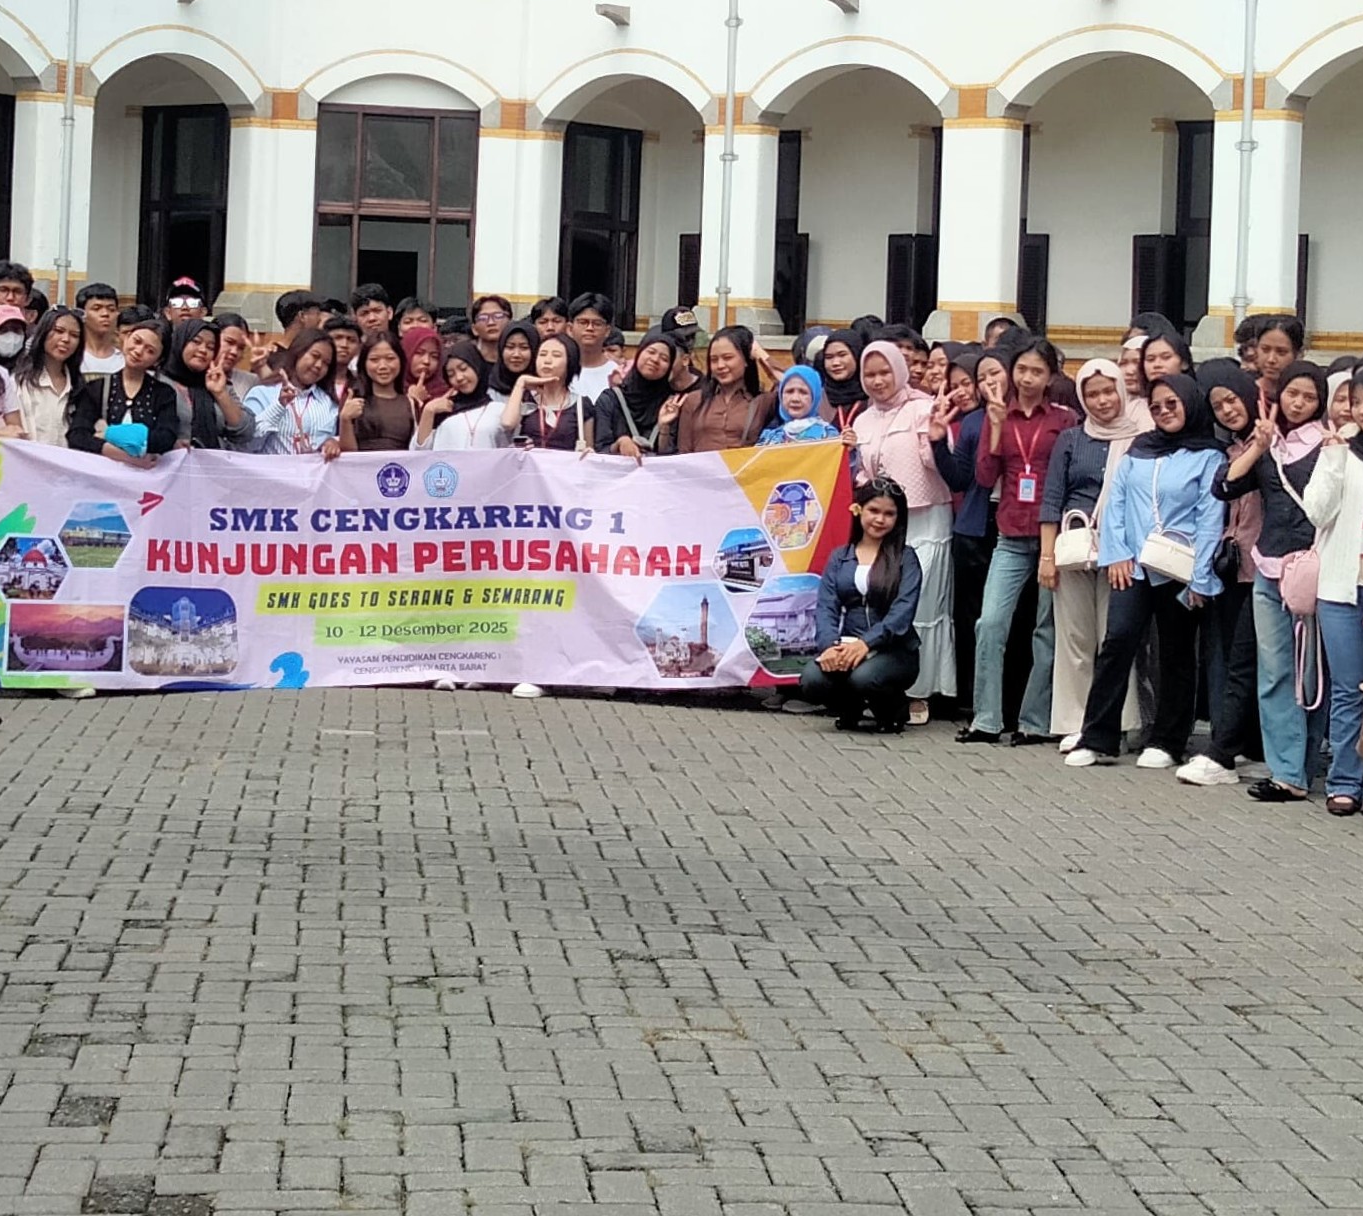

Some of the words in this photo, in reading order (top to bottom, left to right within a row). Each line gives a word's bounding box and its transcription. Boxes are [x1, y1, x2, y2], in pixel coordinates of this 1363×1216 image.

[209, 507, 299, 532] SMK
[310, 505, 593, 532] CENGKARENG
[609, 511, 625, 534] 1
[147, 539, 398, 575] KUNJUNGAN
[413, 539, 701, 577] PERUSAHAAN
[267, 592, 301, 608] SMK
[308, 592, 351, 610] GOES
[360, 591, 379, 607] TO
[388, 589, 455, 607] SERANG
[463, 588, 473, 604] &
[482, 588, 565, 607] SEMARANG
[325, 626, 343, 638] 10
[360, 625, 377, 637] 12
[382, 622, 465, 637] Desember
[469, 621, 508, 634] 2025
[337, 655, 379, 664] YAYASAN
[382, 653, 436, 662] PENDIDIKAN
[438, 651, 497, 660] CENGKARENG
[459, 663, 487, 671] BARAT
